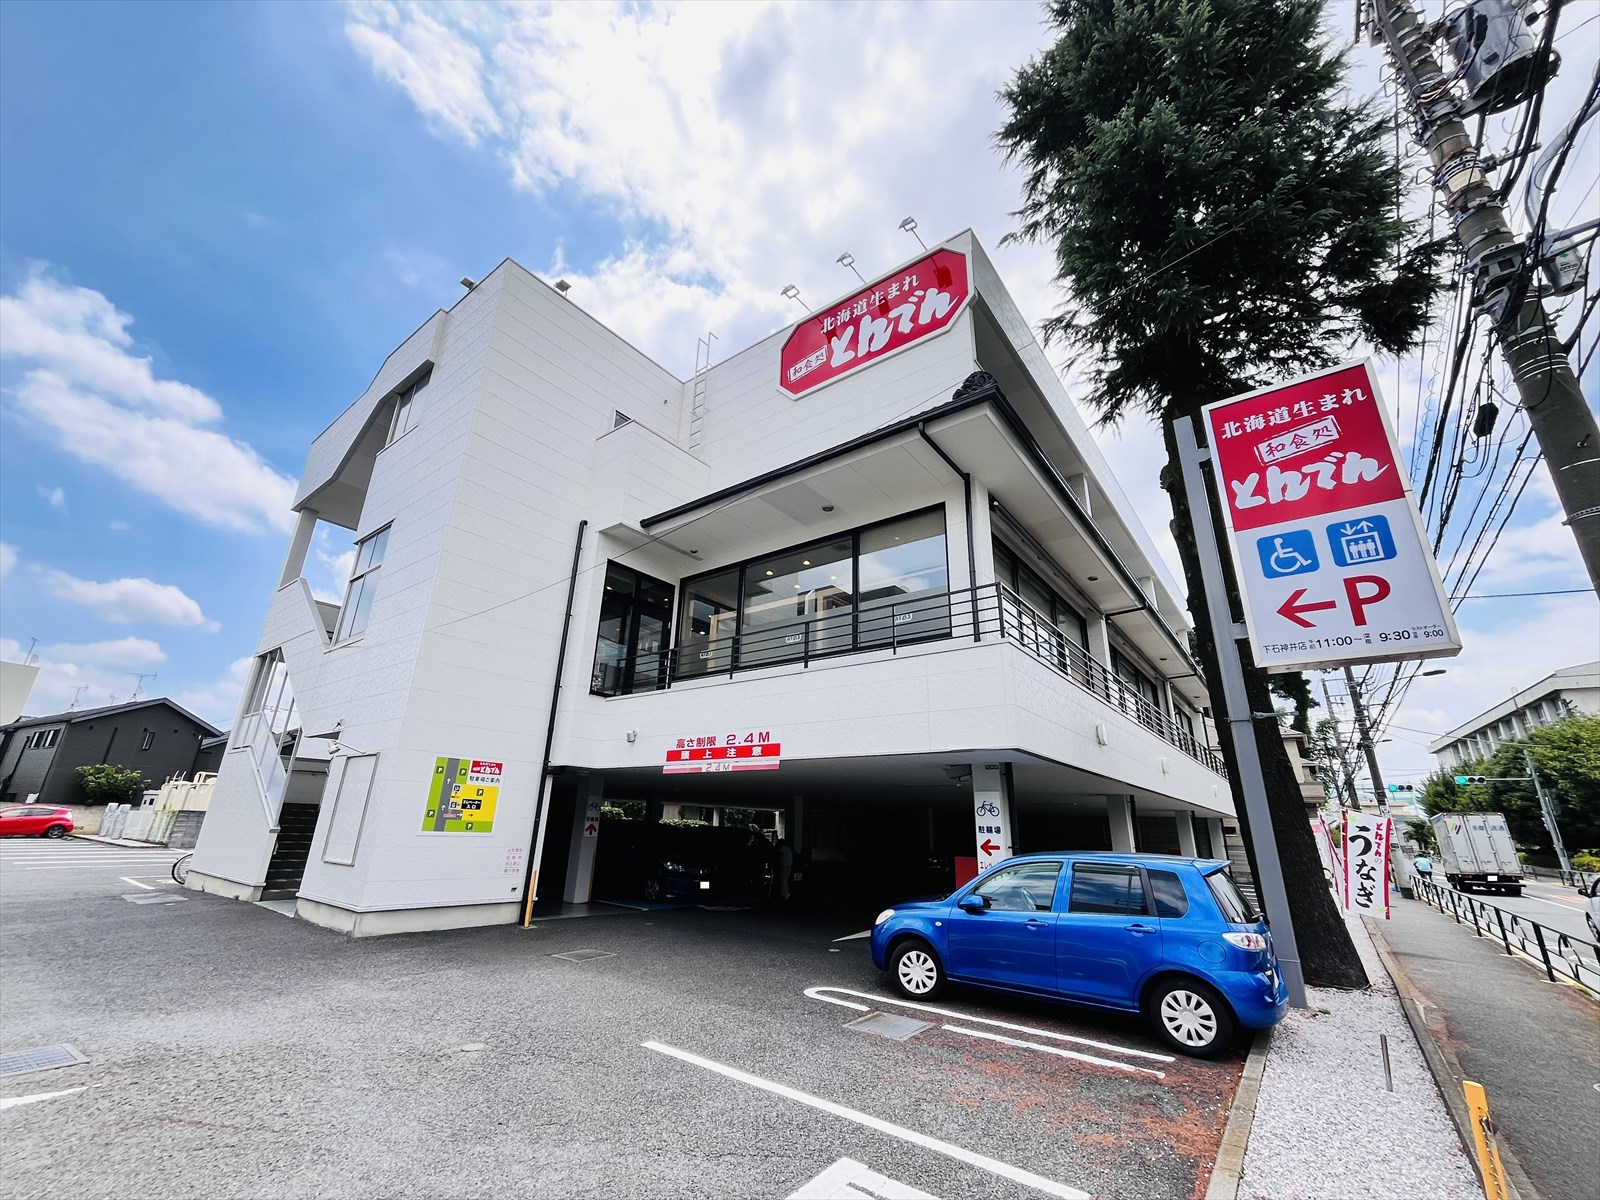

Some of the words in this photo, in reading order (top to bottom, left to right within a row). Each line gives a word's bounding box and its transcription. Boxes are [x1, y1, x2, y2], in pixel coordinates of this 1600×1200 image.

[820, 273, 920, 334] 北海道生まれ
[830, 287, 959, 368] とんでん
[791, 353, 826, 377] 和食処
[1221, 388, 1368, 440] 北海道生まれ
[1264, 423, 1334, 459] 和食処
[1231, 451, 1389, 509] とんでん
[1343, 575, 1392, 627] P
[1262, 641, 1308, 654] 下石神井店
[1379, 630, 1411, 642] 9:30
[1423, 629, 1444, 638] 9:00
[676, 736, 717, 749] 高さ制限
[726, 731, 770, 745] 2.4M
[680, 746, 762, 760] 頭上注意
[1348, 825, 1378, 909] うなぎ
